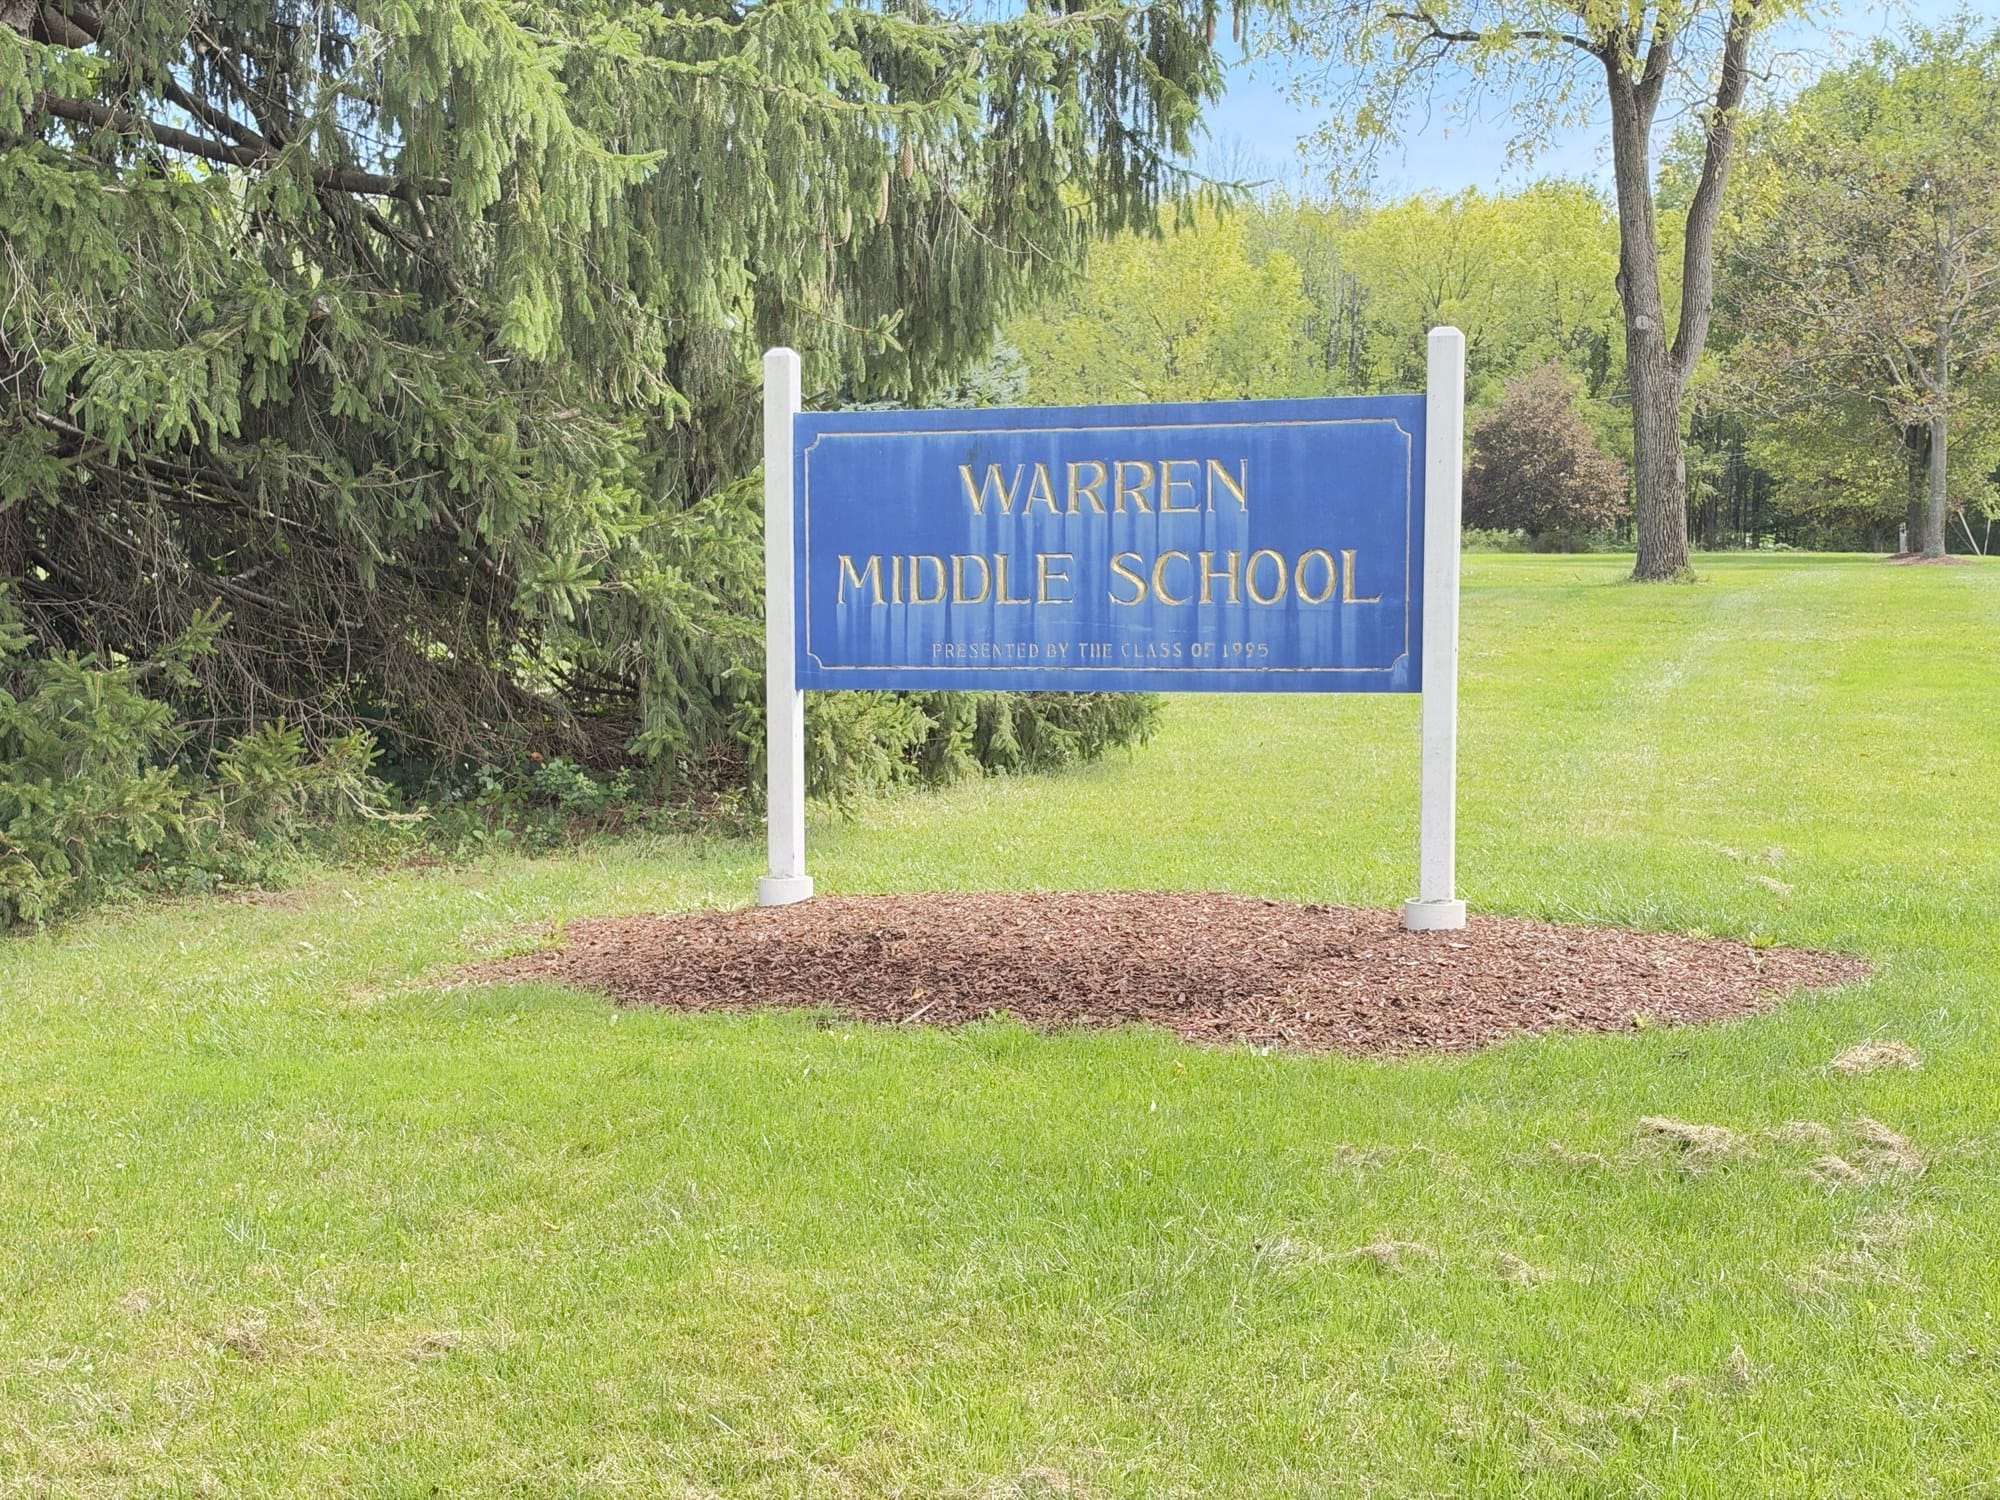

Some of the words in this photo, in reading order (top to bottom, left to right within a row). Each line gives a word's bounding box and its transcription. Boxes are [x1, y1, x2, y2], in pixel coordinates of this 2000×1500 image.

[957, 458, 1248, 515] WARREN
[836, 552, 1077, 605] MIDDLE
[1107, 549, 1382, 605] SCHOOL
[932, 641, 1040, 659] PRESENTED
[1048, 641, 1069, 659] BY
[1078, 642, 1113, 659] THE
[1120, 642, 1182, 659] CLASS
[1191, 642, 1215, 659] OF
[1222, 642, 1270, 659] 1995
